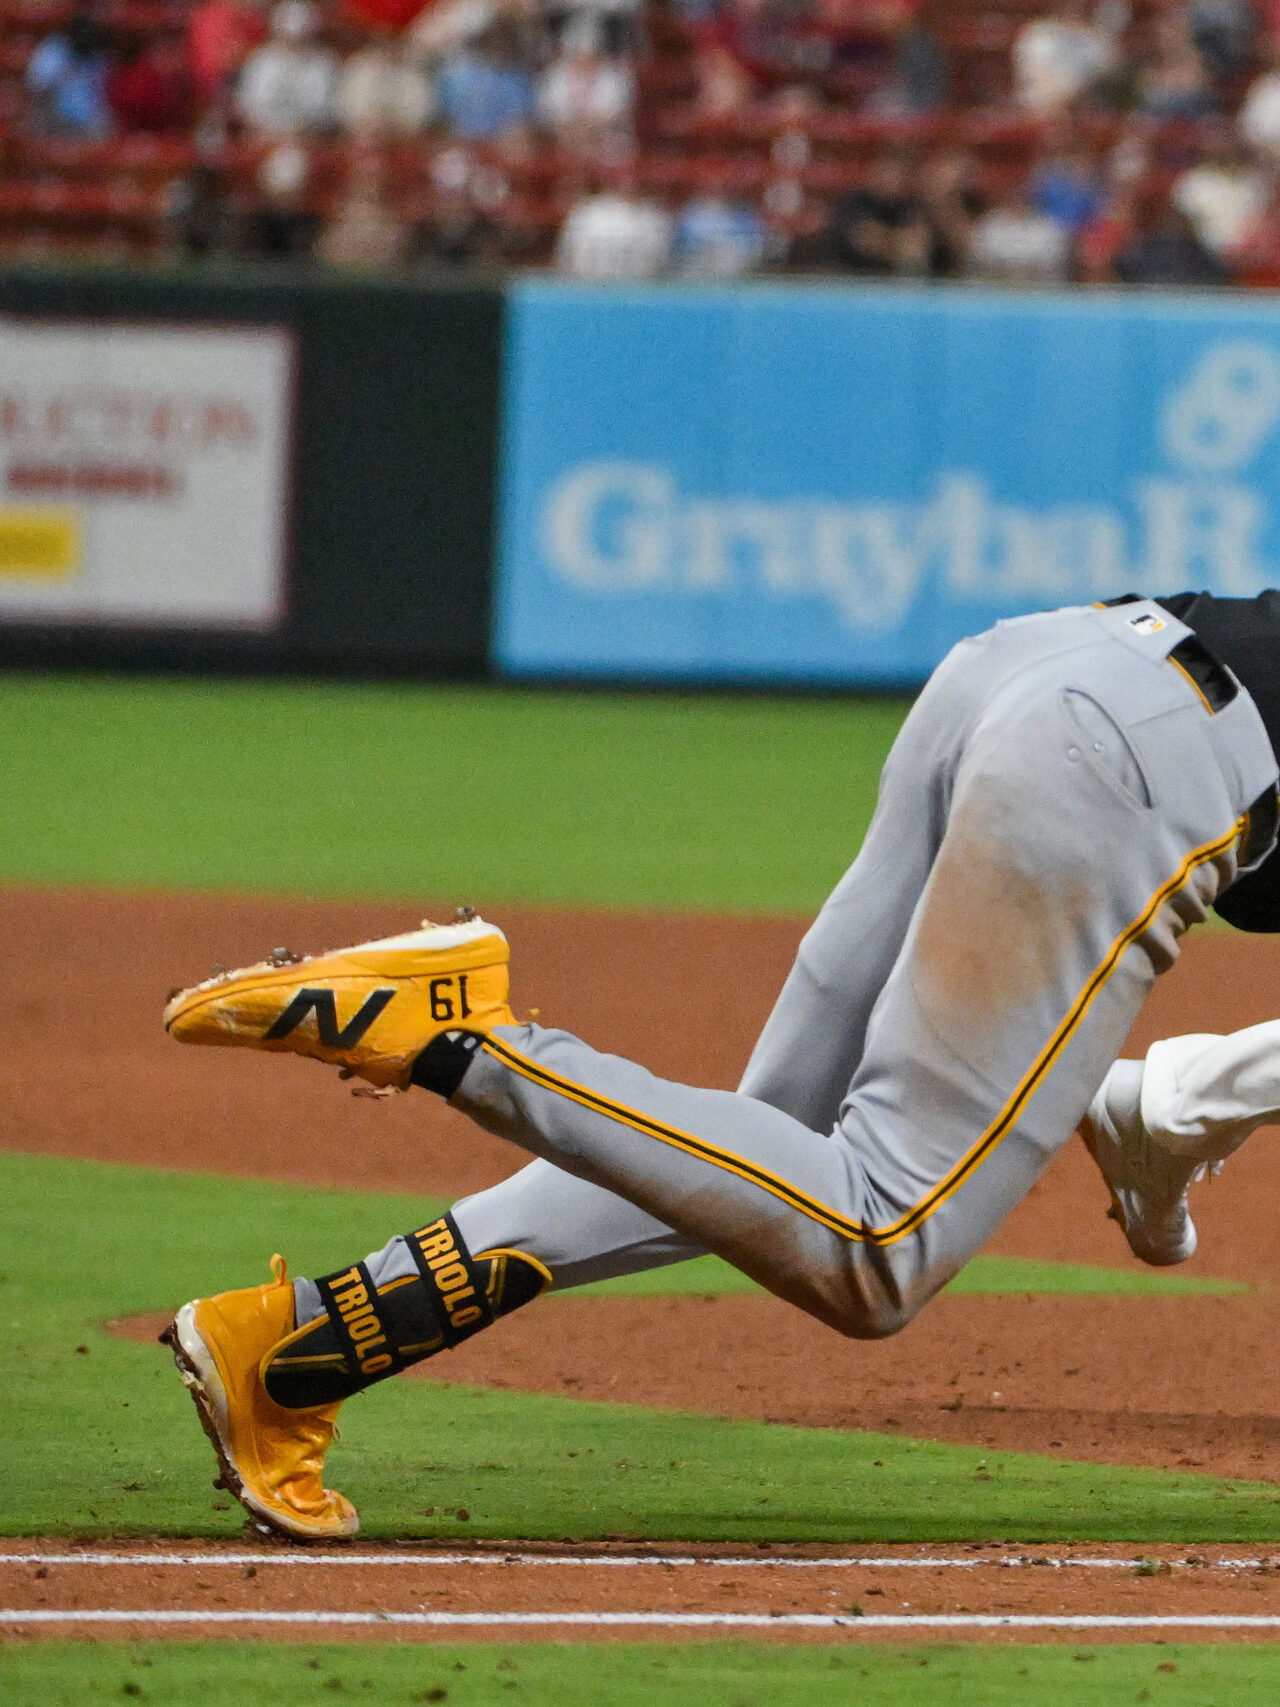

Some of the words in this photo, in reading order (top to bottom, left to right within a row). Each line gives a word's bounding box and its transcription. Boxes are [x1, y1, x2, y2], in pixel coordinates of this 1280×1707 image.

[429, 974, 473, 1022] 19
[328, 1267, 393, 1374] TRIOLO
[414, 1218, 482, 1328] TRIOLO
